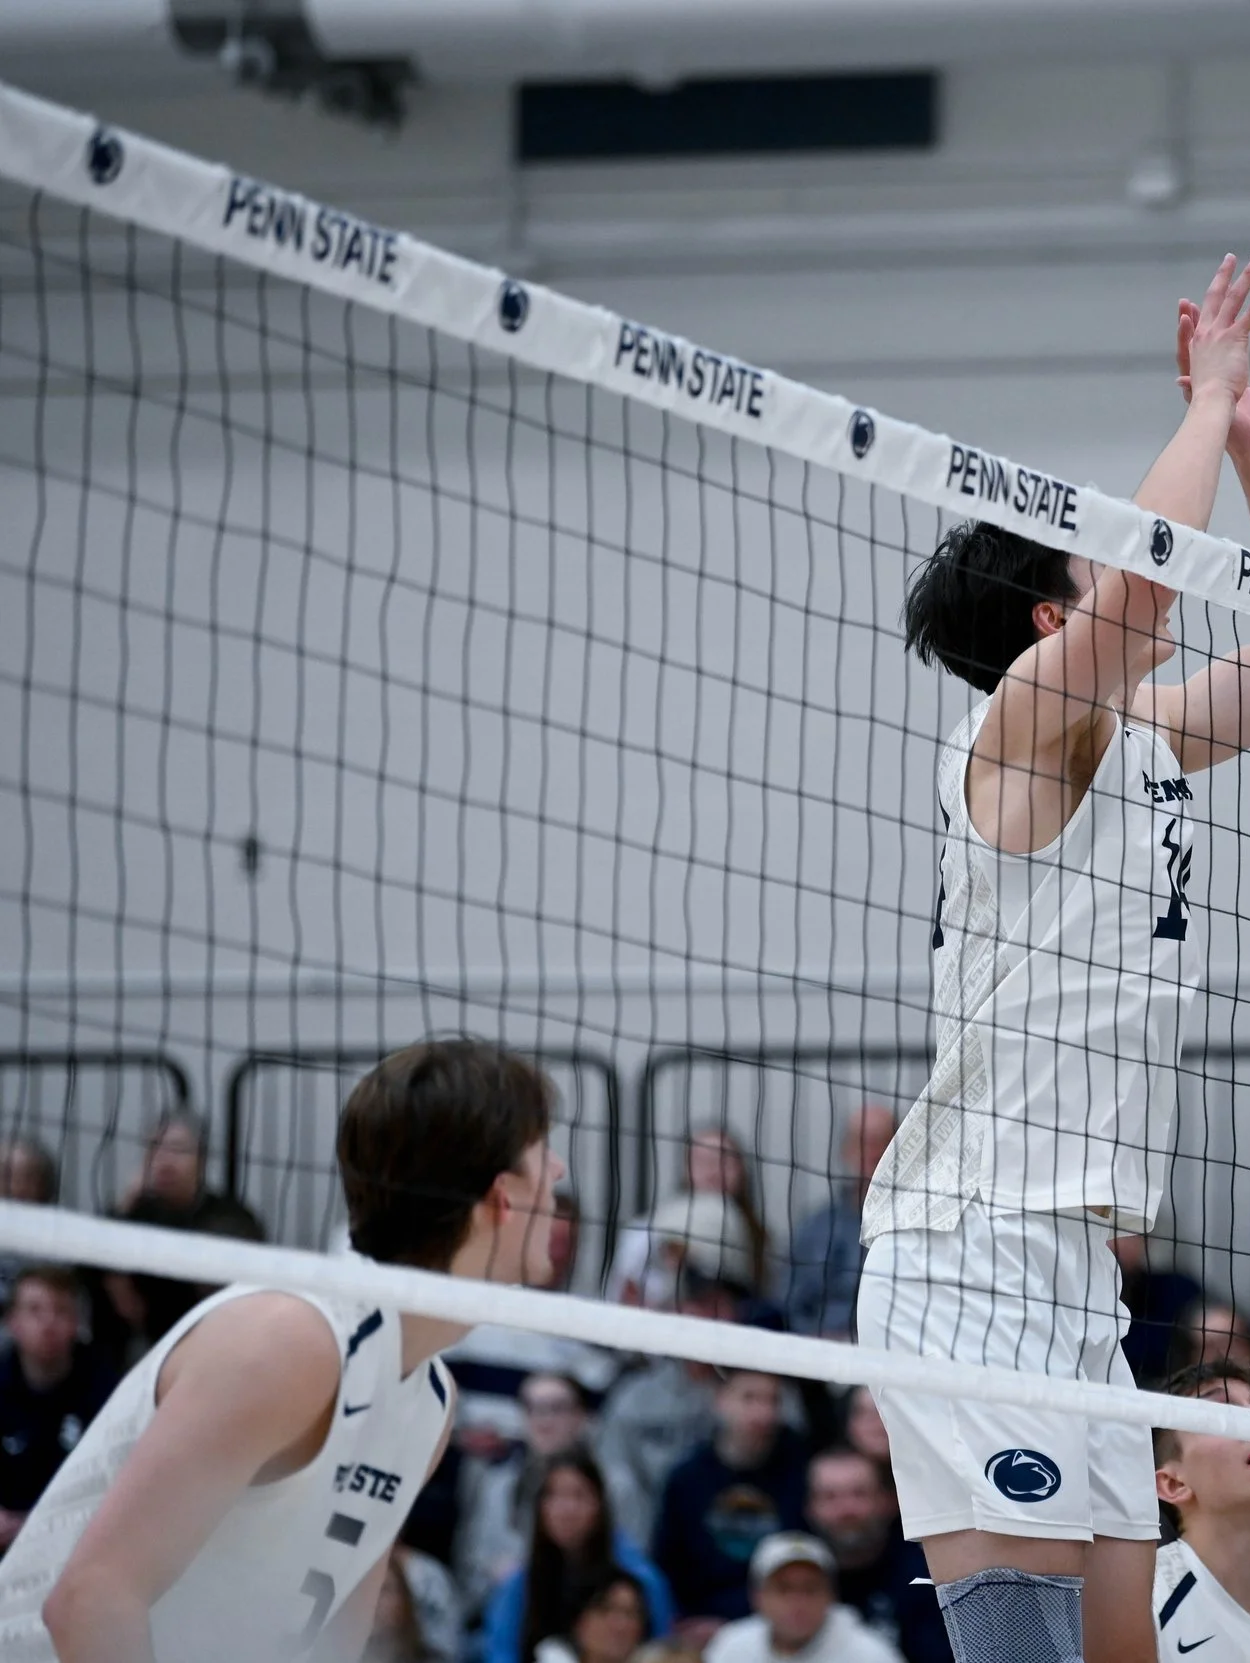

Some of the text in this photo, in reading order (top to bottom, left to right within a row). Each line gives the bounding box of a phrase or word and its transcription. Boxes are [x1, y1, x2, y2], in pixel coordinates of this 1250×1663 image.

[223, 179, 397, 283] PENN STATE
[615, 322, 763, 418] PENN STATE
[946, 444, 1077, 531] PENN STATE
